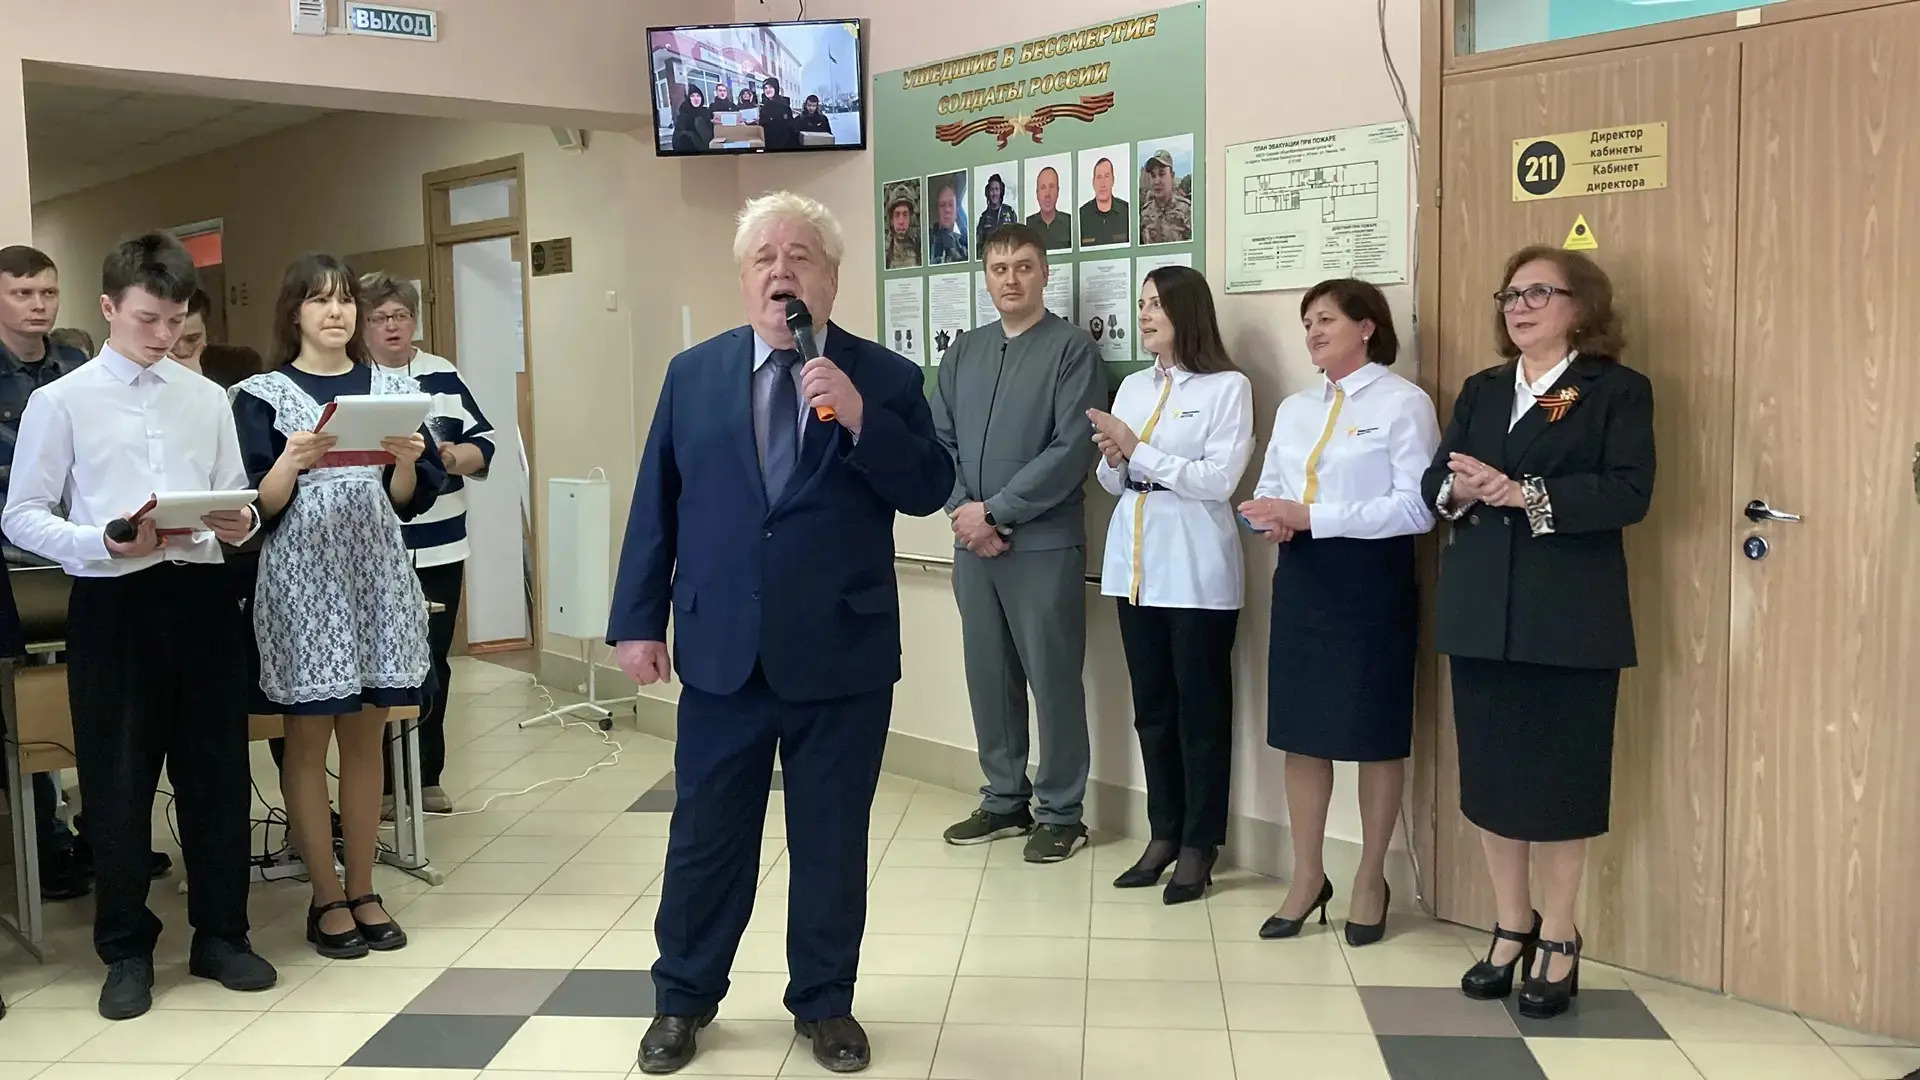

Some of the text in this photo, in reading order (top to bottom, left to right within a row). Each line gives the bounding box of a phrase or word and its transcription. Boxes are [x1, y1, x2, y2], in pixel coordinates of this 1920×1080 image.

[356, 9, 428, 35] ВЫХОД
[902, 13, 1158, 90] УШЕДШИЕ В БЕССМЕРТИЕ
[937, 62, 1110, 116] СОЛДАТЫ РОССИИ
[1268, 141, 1300, 150] ЭВАКУАЦИИ
[1312, 135, 1336, 143] ПОЖАРЕ
[1590, 128, 1643, 144] Директор
[1590, 144, 1643, 158] кабинеты
[1525, 154, 1557, 183] 211
[1592, 162, 1640, 176] Кабинет
[1586, 178, 1645, 193] директора
